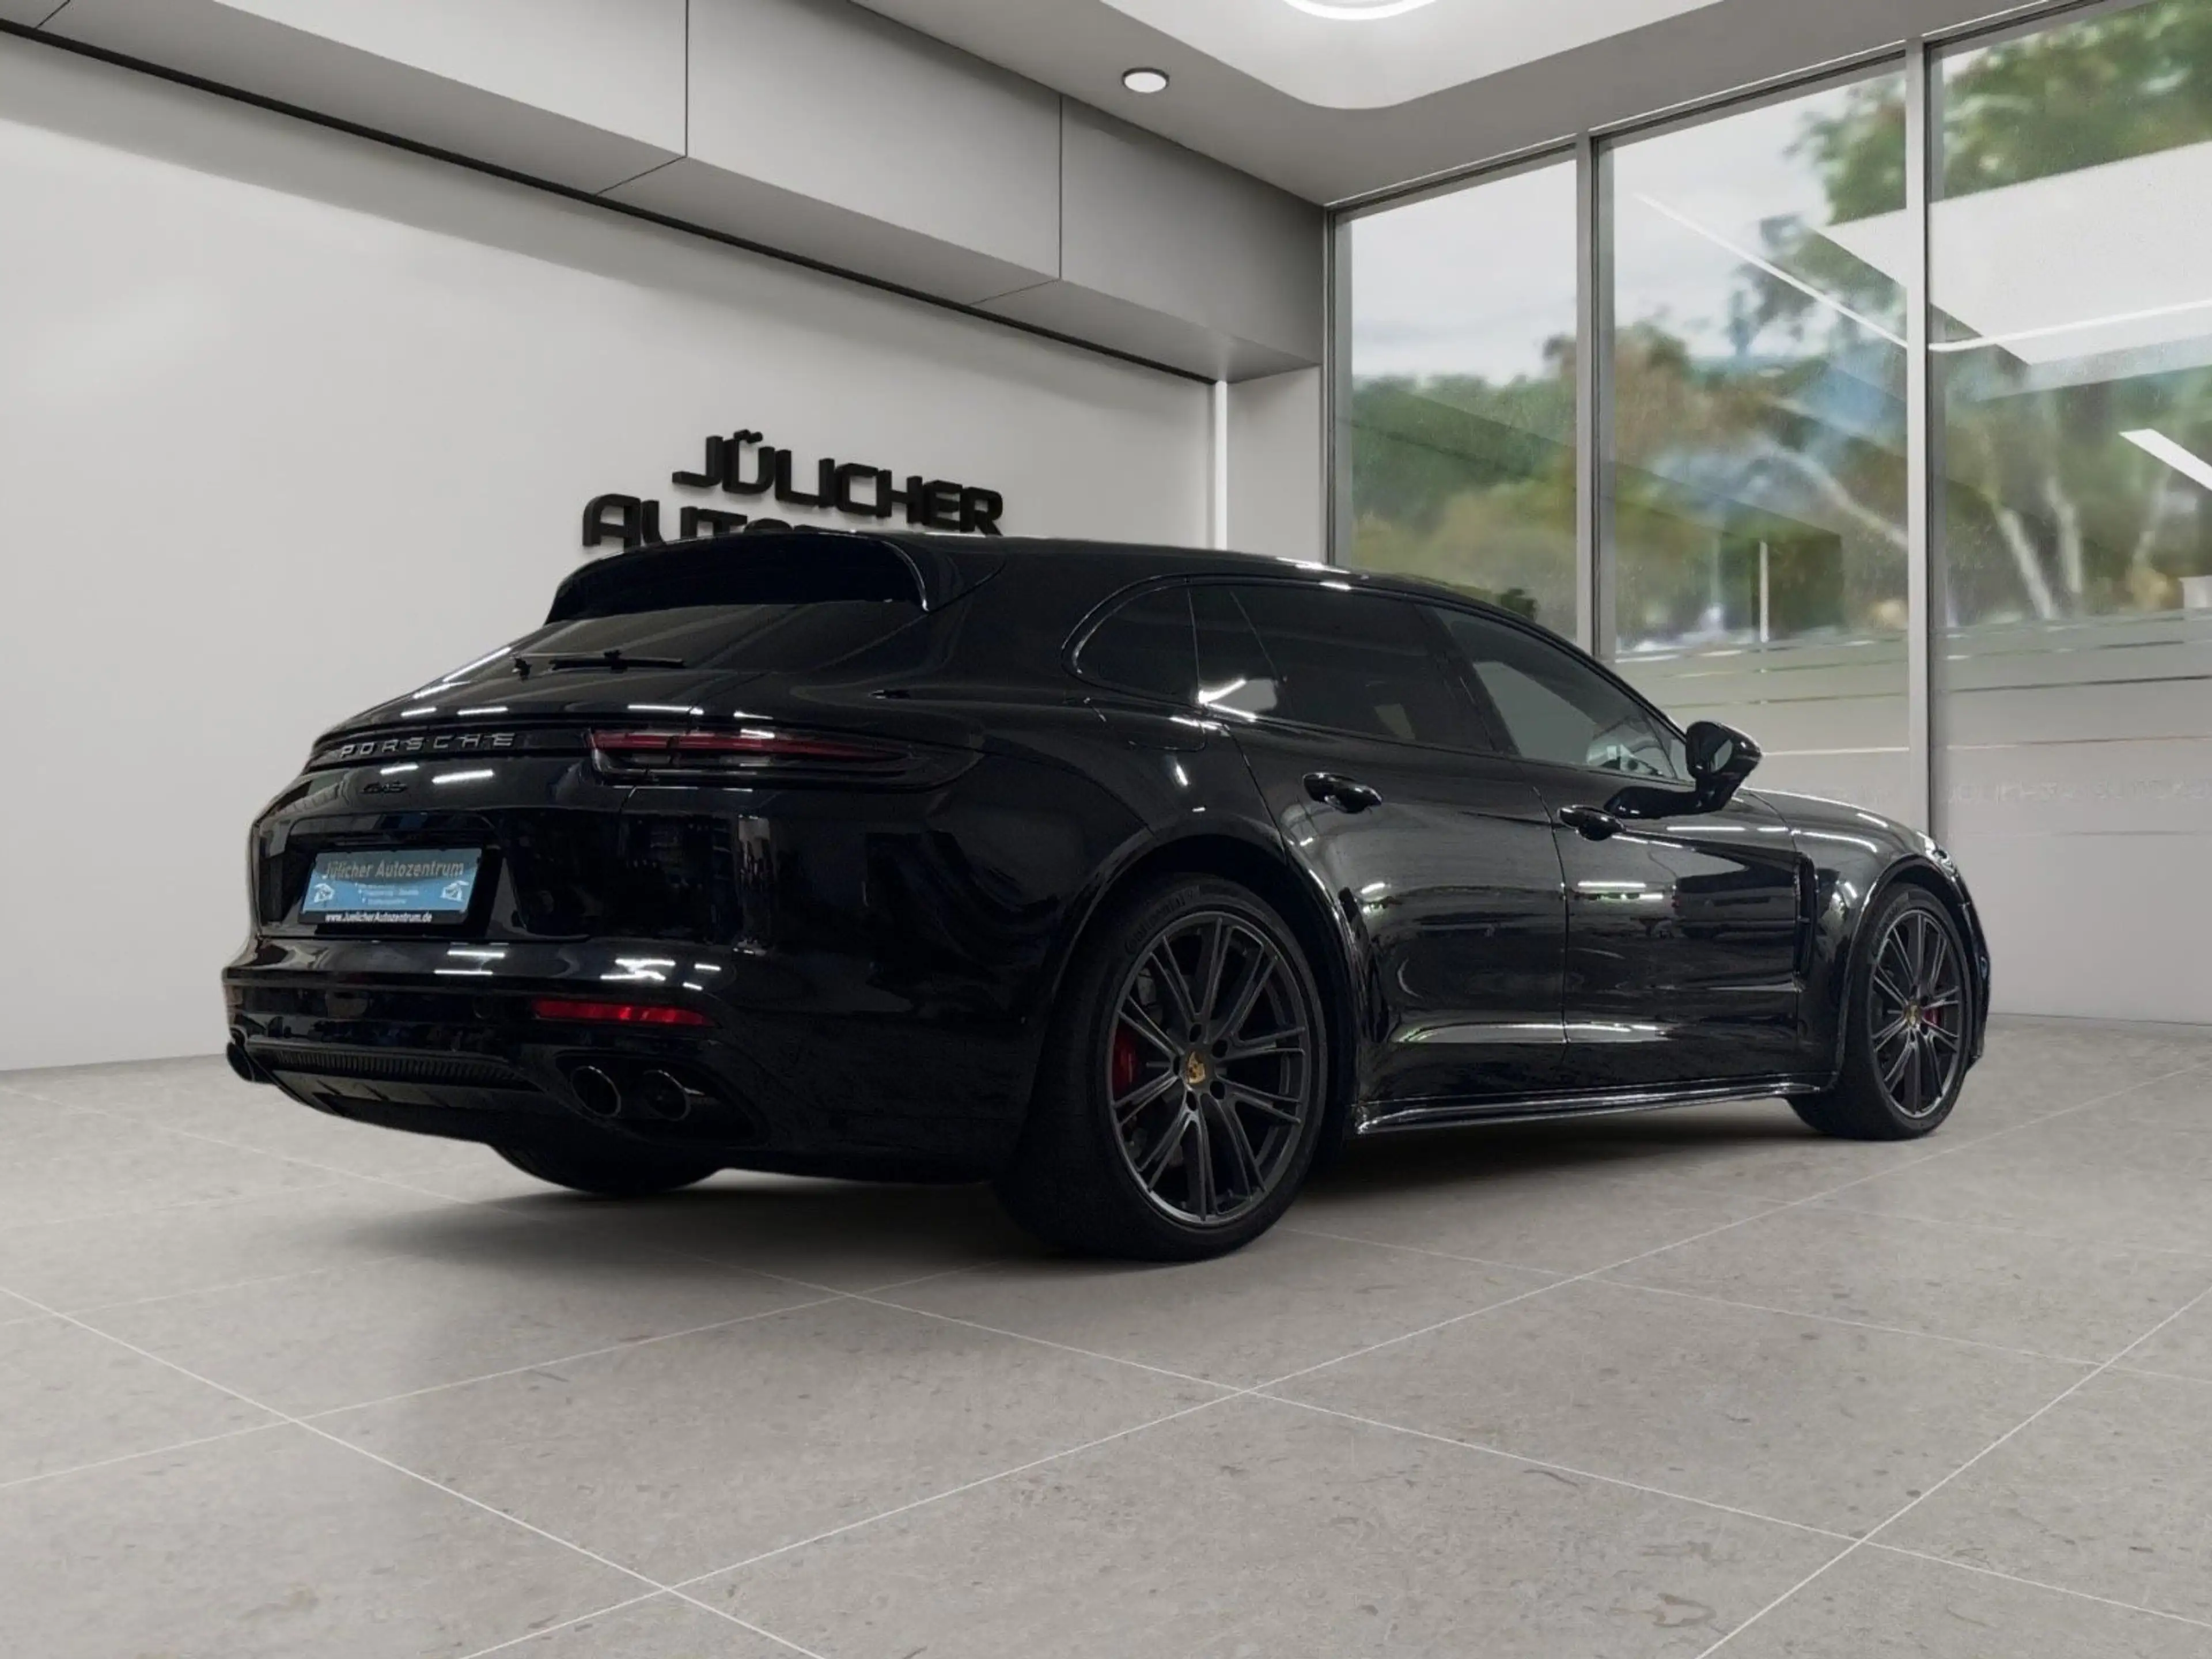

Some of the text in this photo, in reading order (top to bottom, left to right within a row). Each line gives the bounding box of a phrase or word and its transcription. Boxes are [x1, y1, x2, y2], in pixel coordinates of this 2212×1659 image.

[672, 429, 1003, 536] JÜLICHER
[339, 732, 516, 759] PORSCHE
[322, 858, 464, 880] Jülicher Autozentrum
